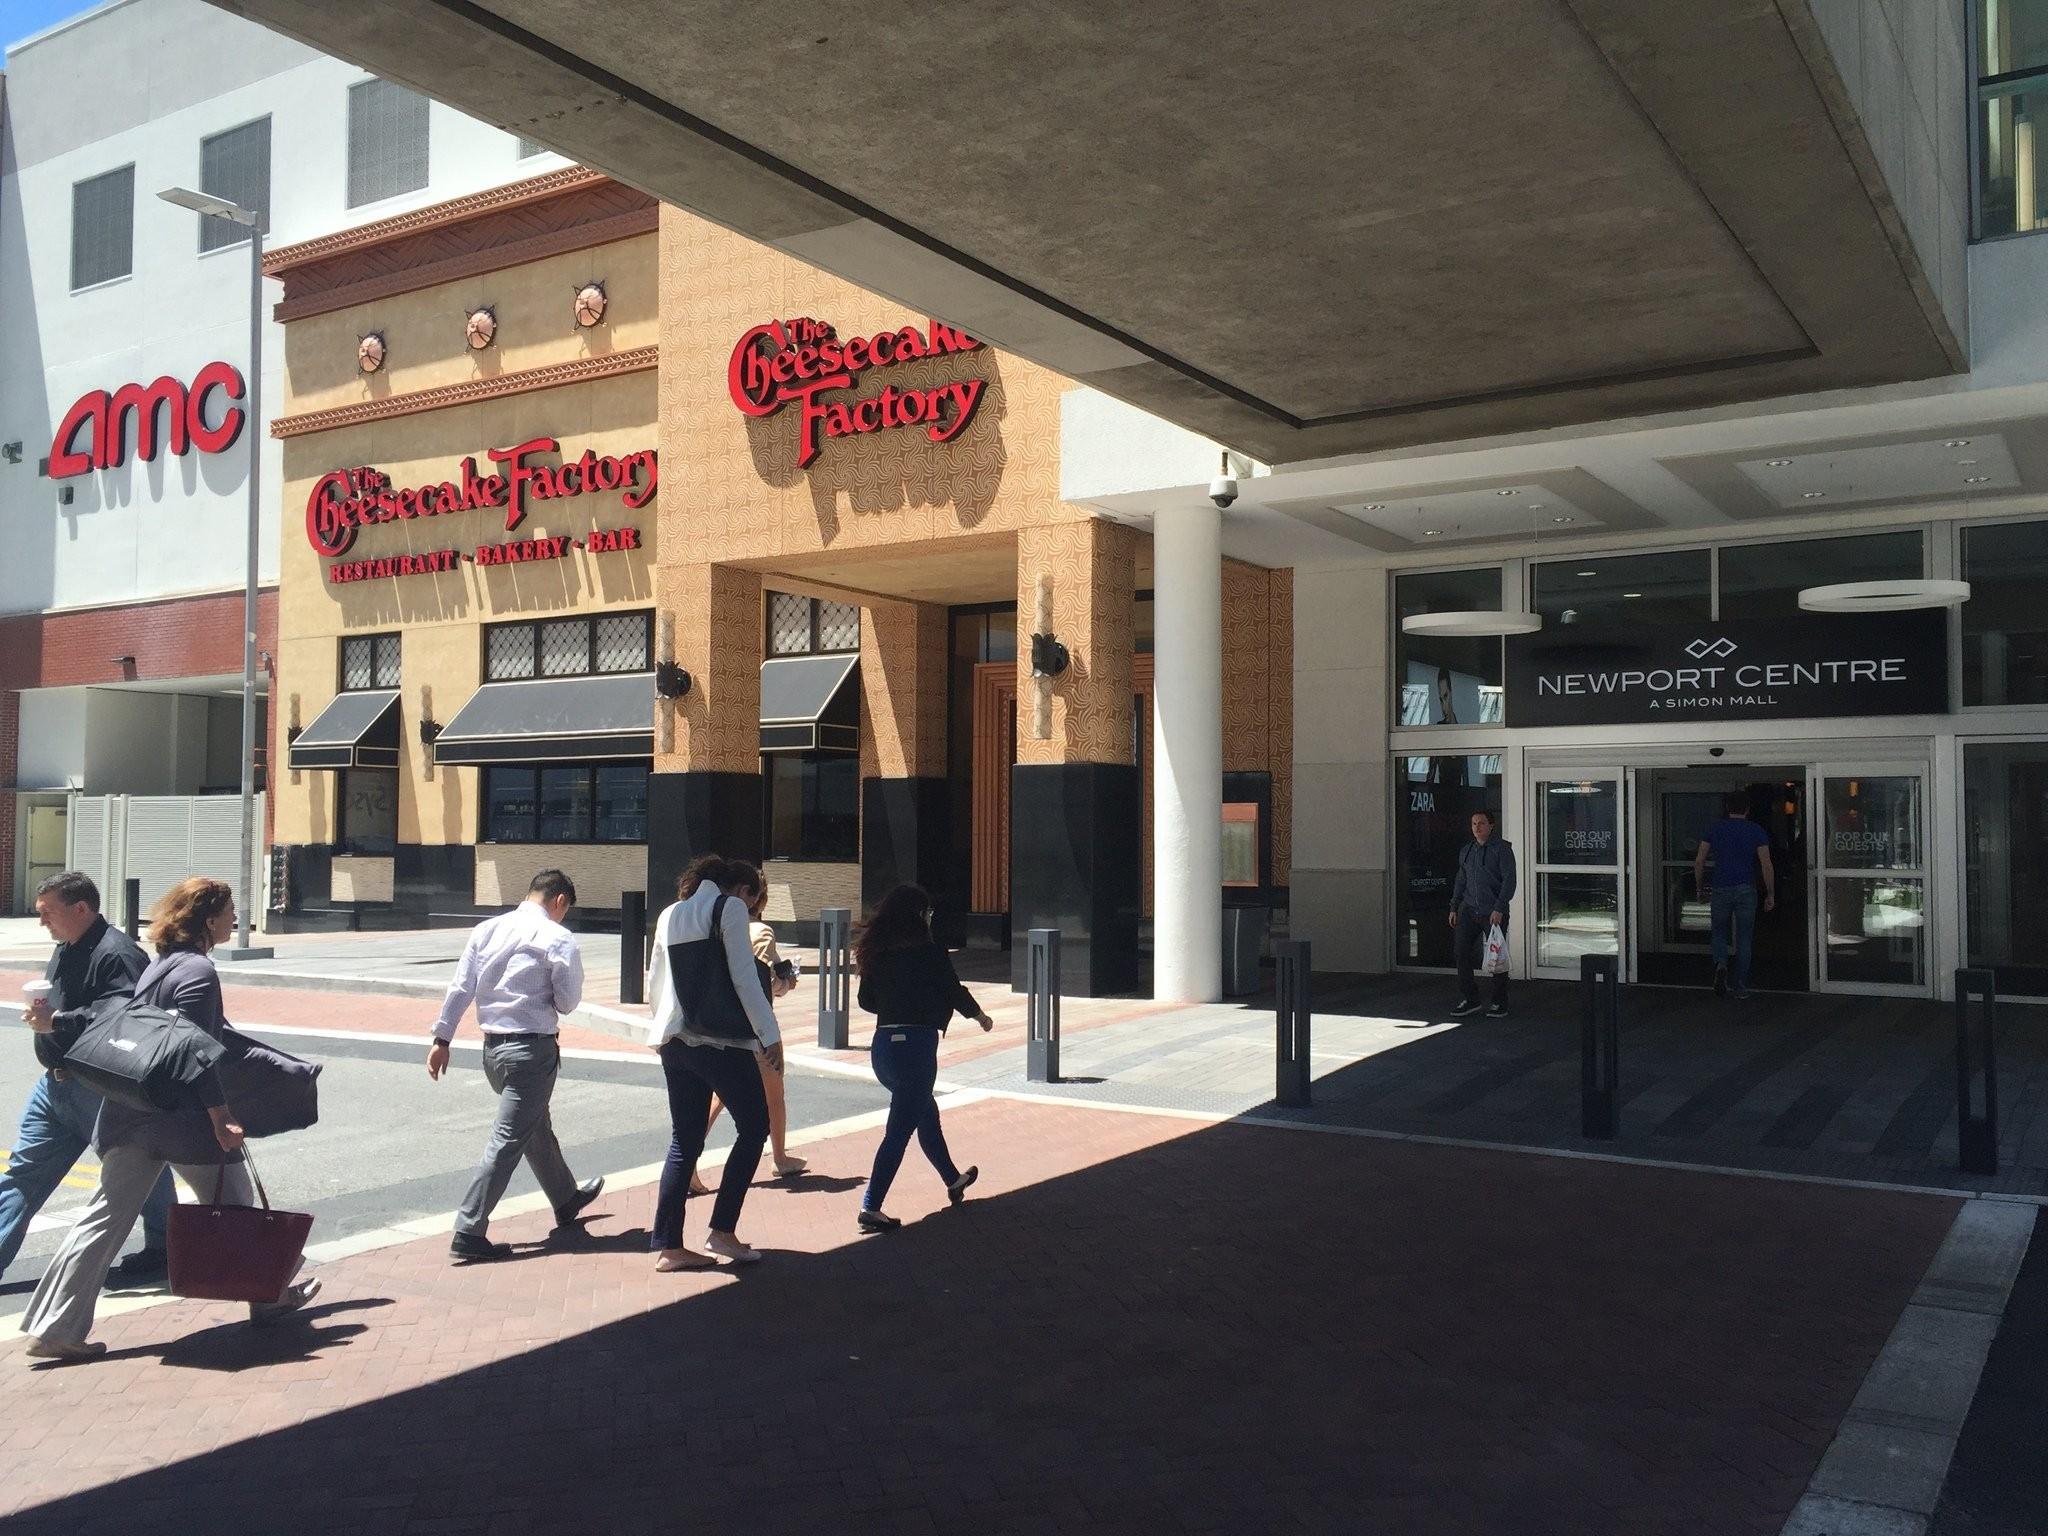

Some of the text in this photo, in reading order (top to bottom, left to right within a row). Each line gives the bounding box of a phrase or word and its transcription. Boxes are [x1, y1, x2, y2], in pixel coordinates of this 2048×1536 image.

[785, 317, 836, 345] The
[777, 373, 988, 469] Factory
[349, 466, 391, 492] The
[306, 437, 658, 557] Cheesecake Factory
[330, 527, 641, 583] RESTAURANT BAKERY BAR
[1538, 658, 1907, 696] NEWPORT CENTRE
[1649, 695, 1778, 708] A SIMON MALL
[1410, 791, 1435, 812] ZARA
[1565, 831, 1611, 840] FOR OUR
[1565, 840, 1607, 849] GUESTS
[1835, 831, 1861, 841] FOR
[1835, 841, 1885, 851] GUESTS
